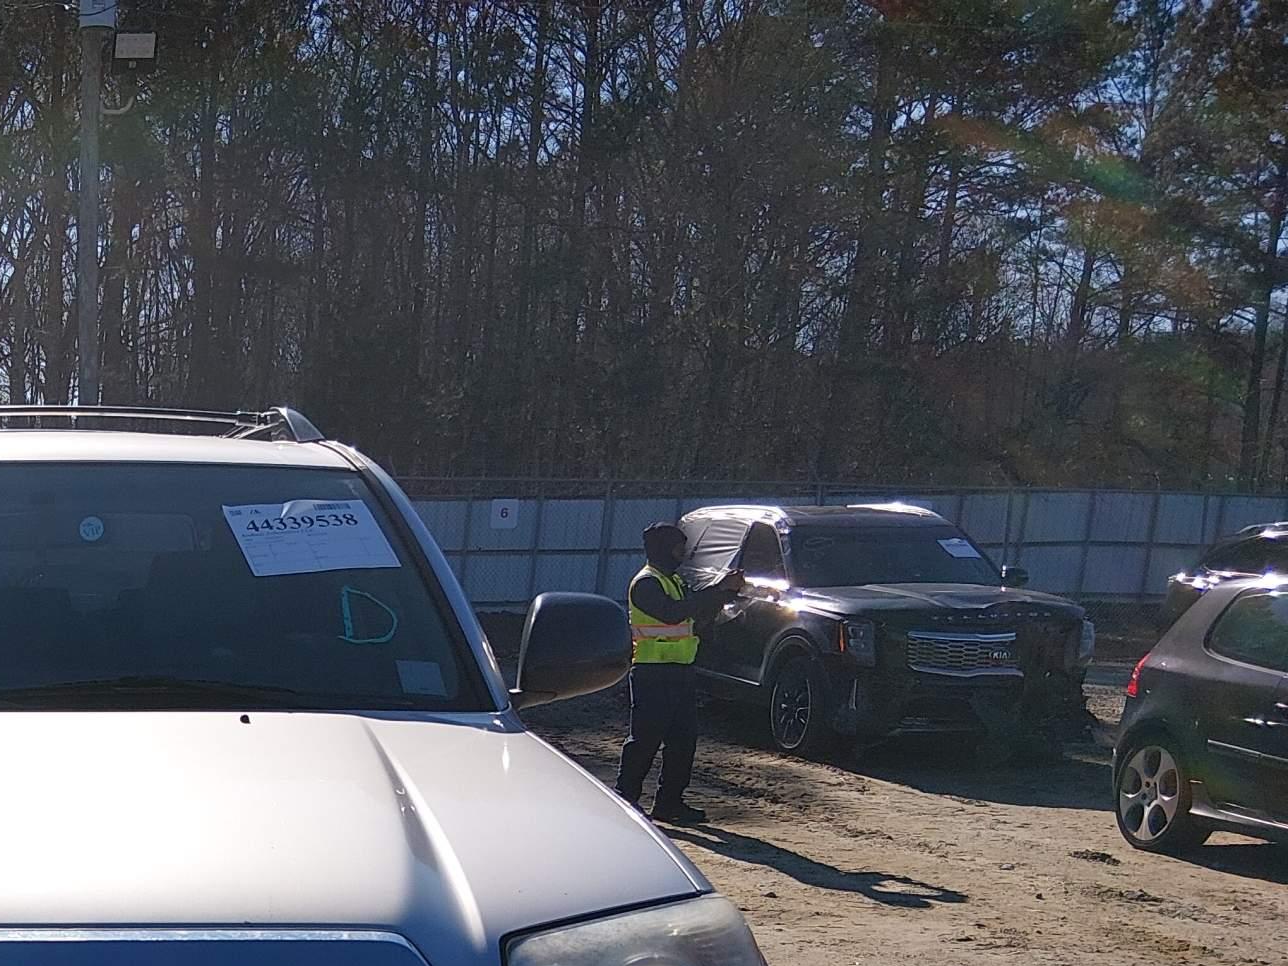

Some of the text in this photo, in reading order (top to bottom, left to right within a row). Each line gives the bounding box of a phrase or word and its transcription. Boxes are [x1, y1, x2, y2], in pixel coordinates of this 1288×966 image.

[500, 507, 508, 518] 6
[246, 513, 359, 533] 44339538
[337, 585, 398, 645] D
[991, 650, 1008, 660] KIA
